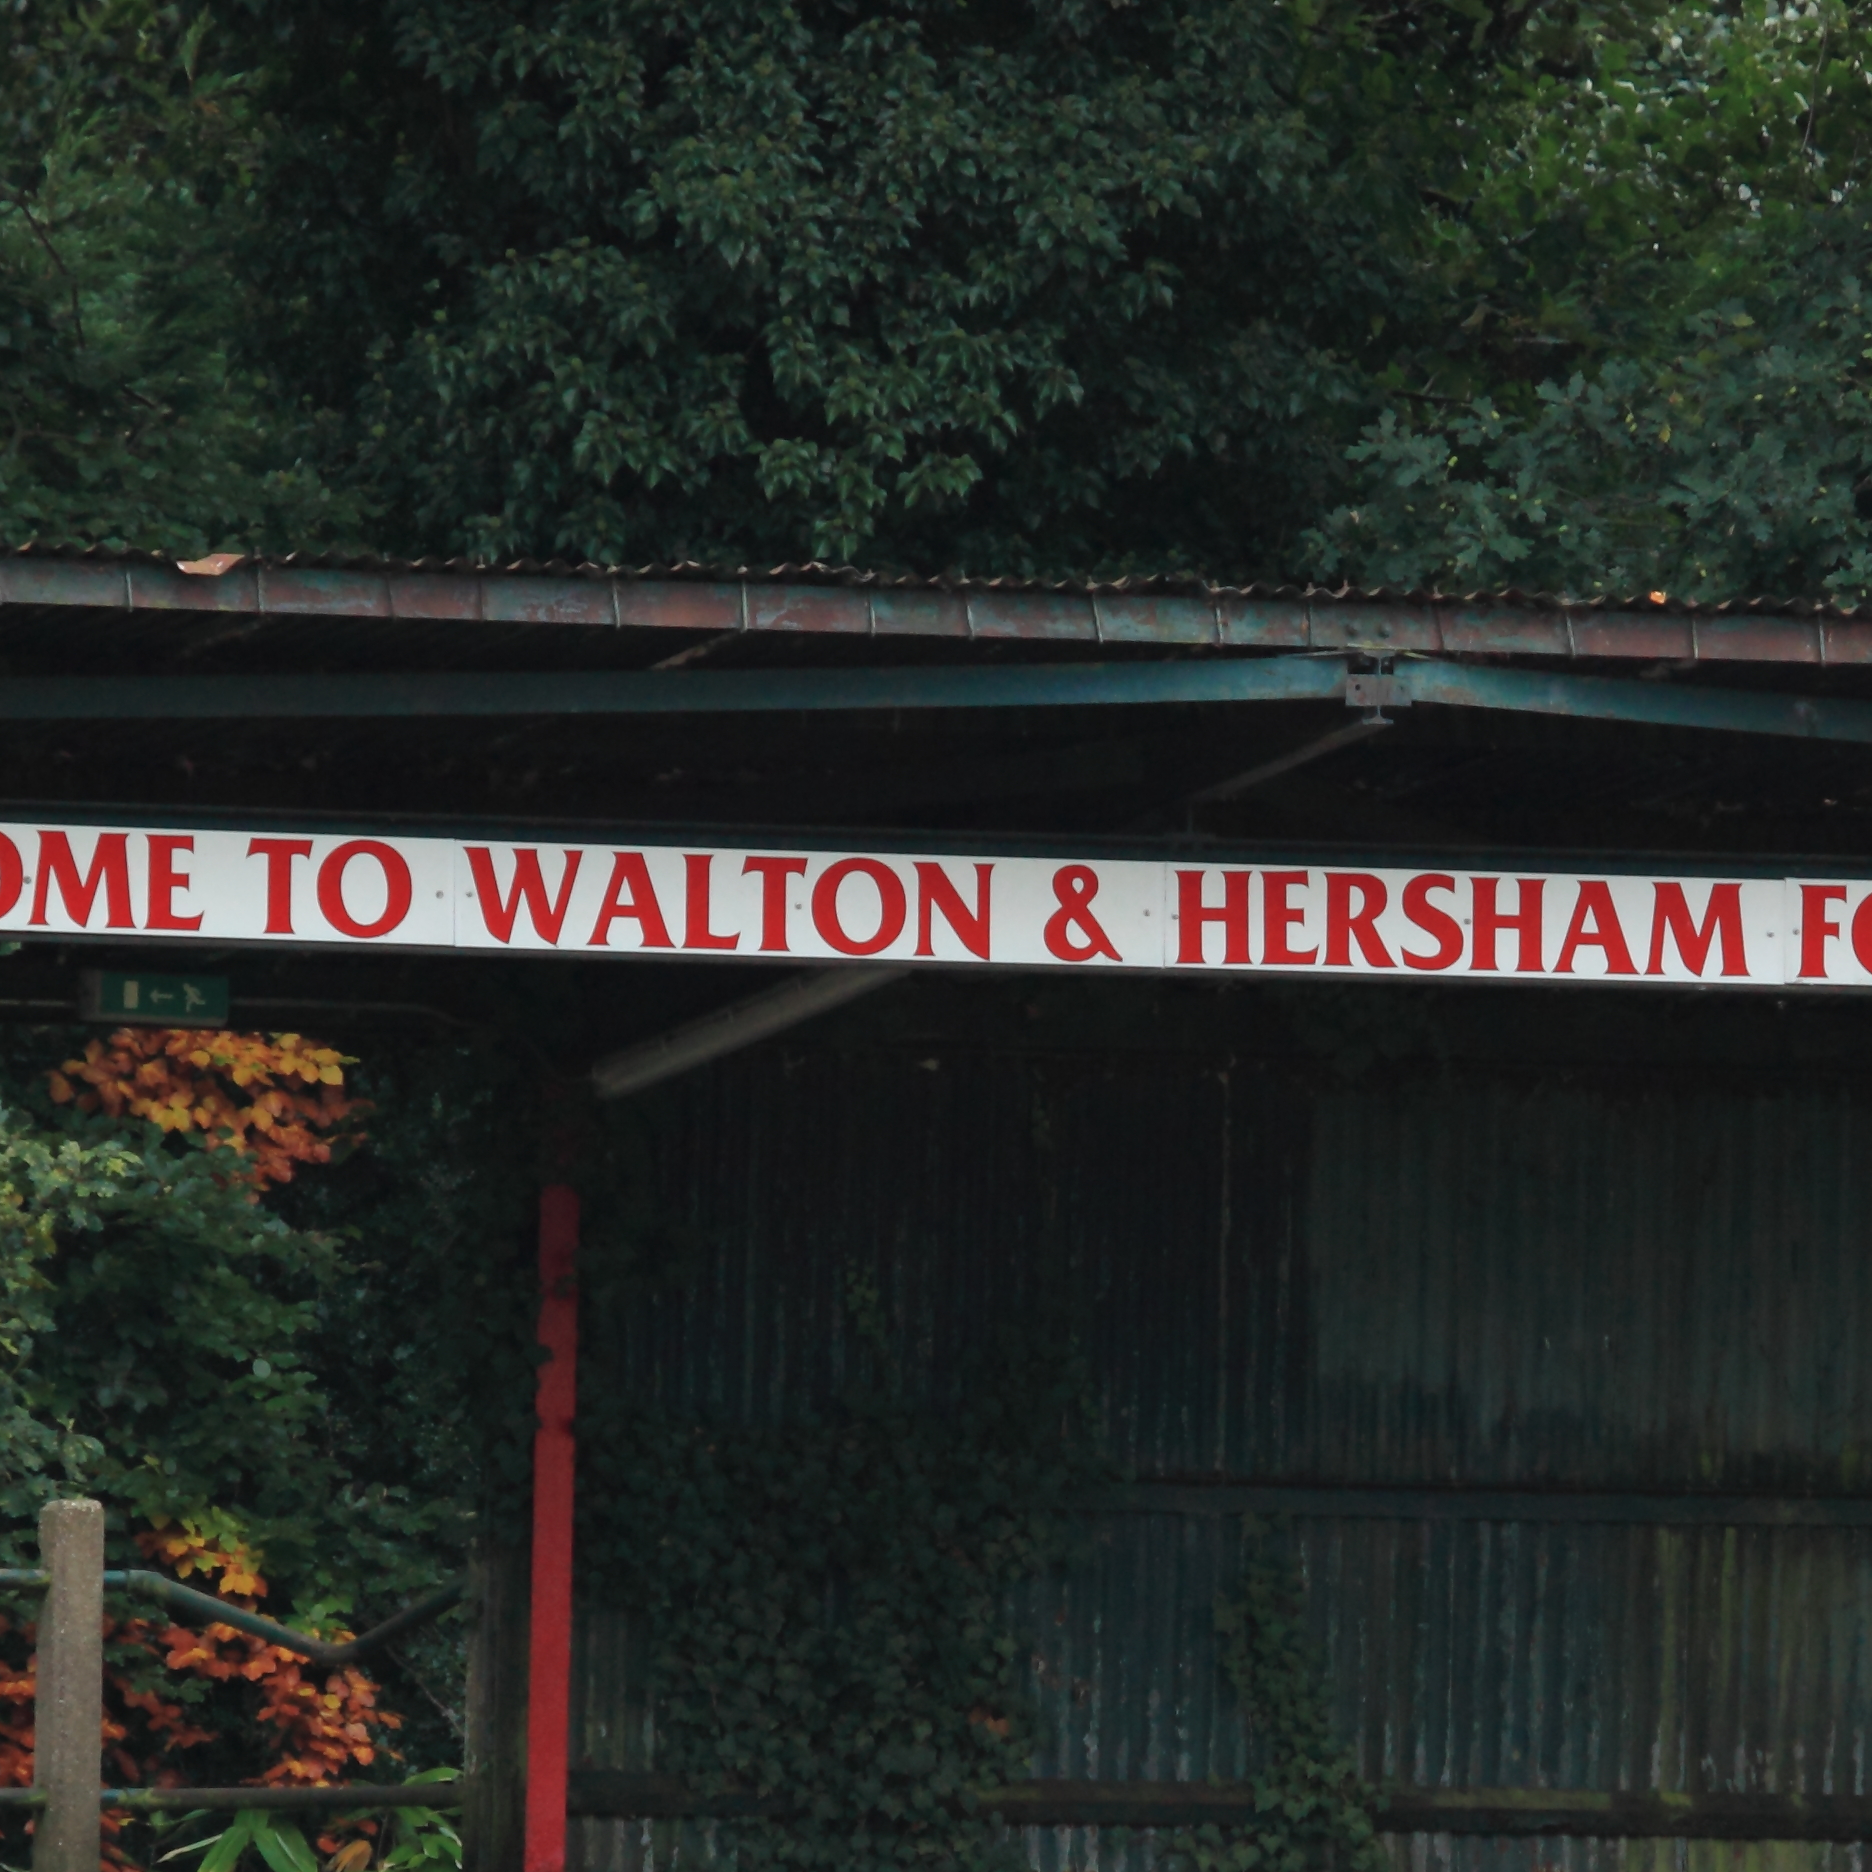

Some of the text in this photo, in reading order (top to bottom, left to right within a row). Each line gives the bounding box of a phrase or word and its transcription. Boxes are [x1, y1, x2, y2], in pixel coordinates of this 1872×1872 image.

[247, 837, 413, 939] TO
[464, 846, 994, 961] WALTON
[1043, 864, 1123, 963] &
[1176, 869, 1750, 977] HERSHAM
